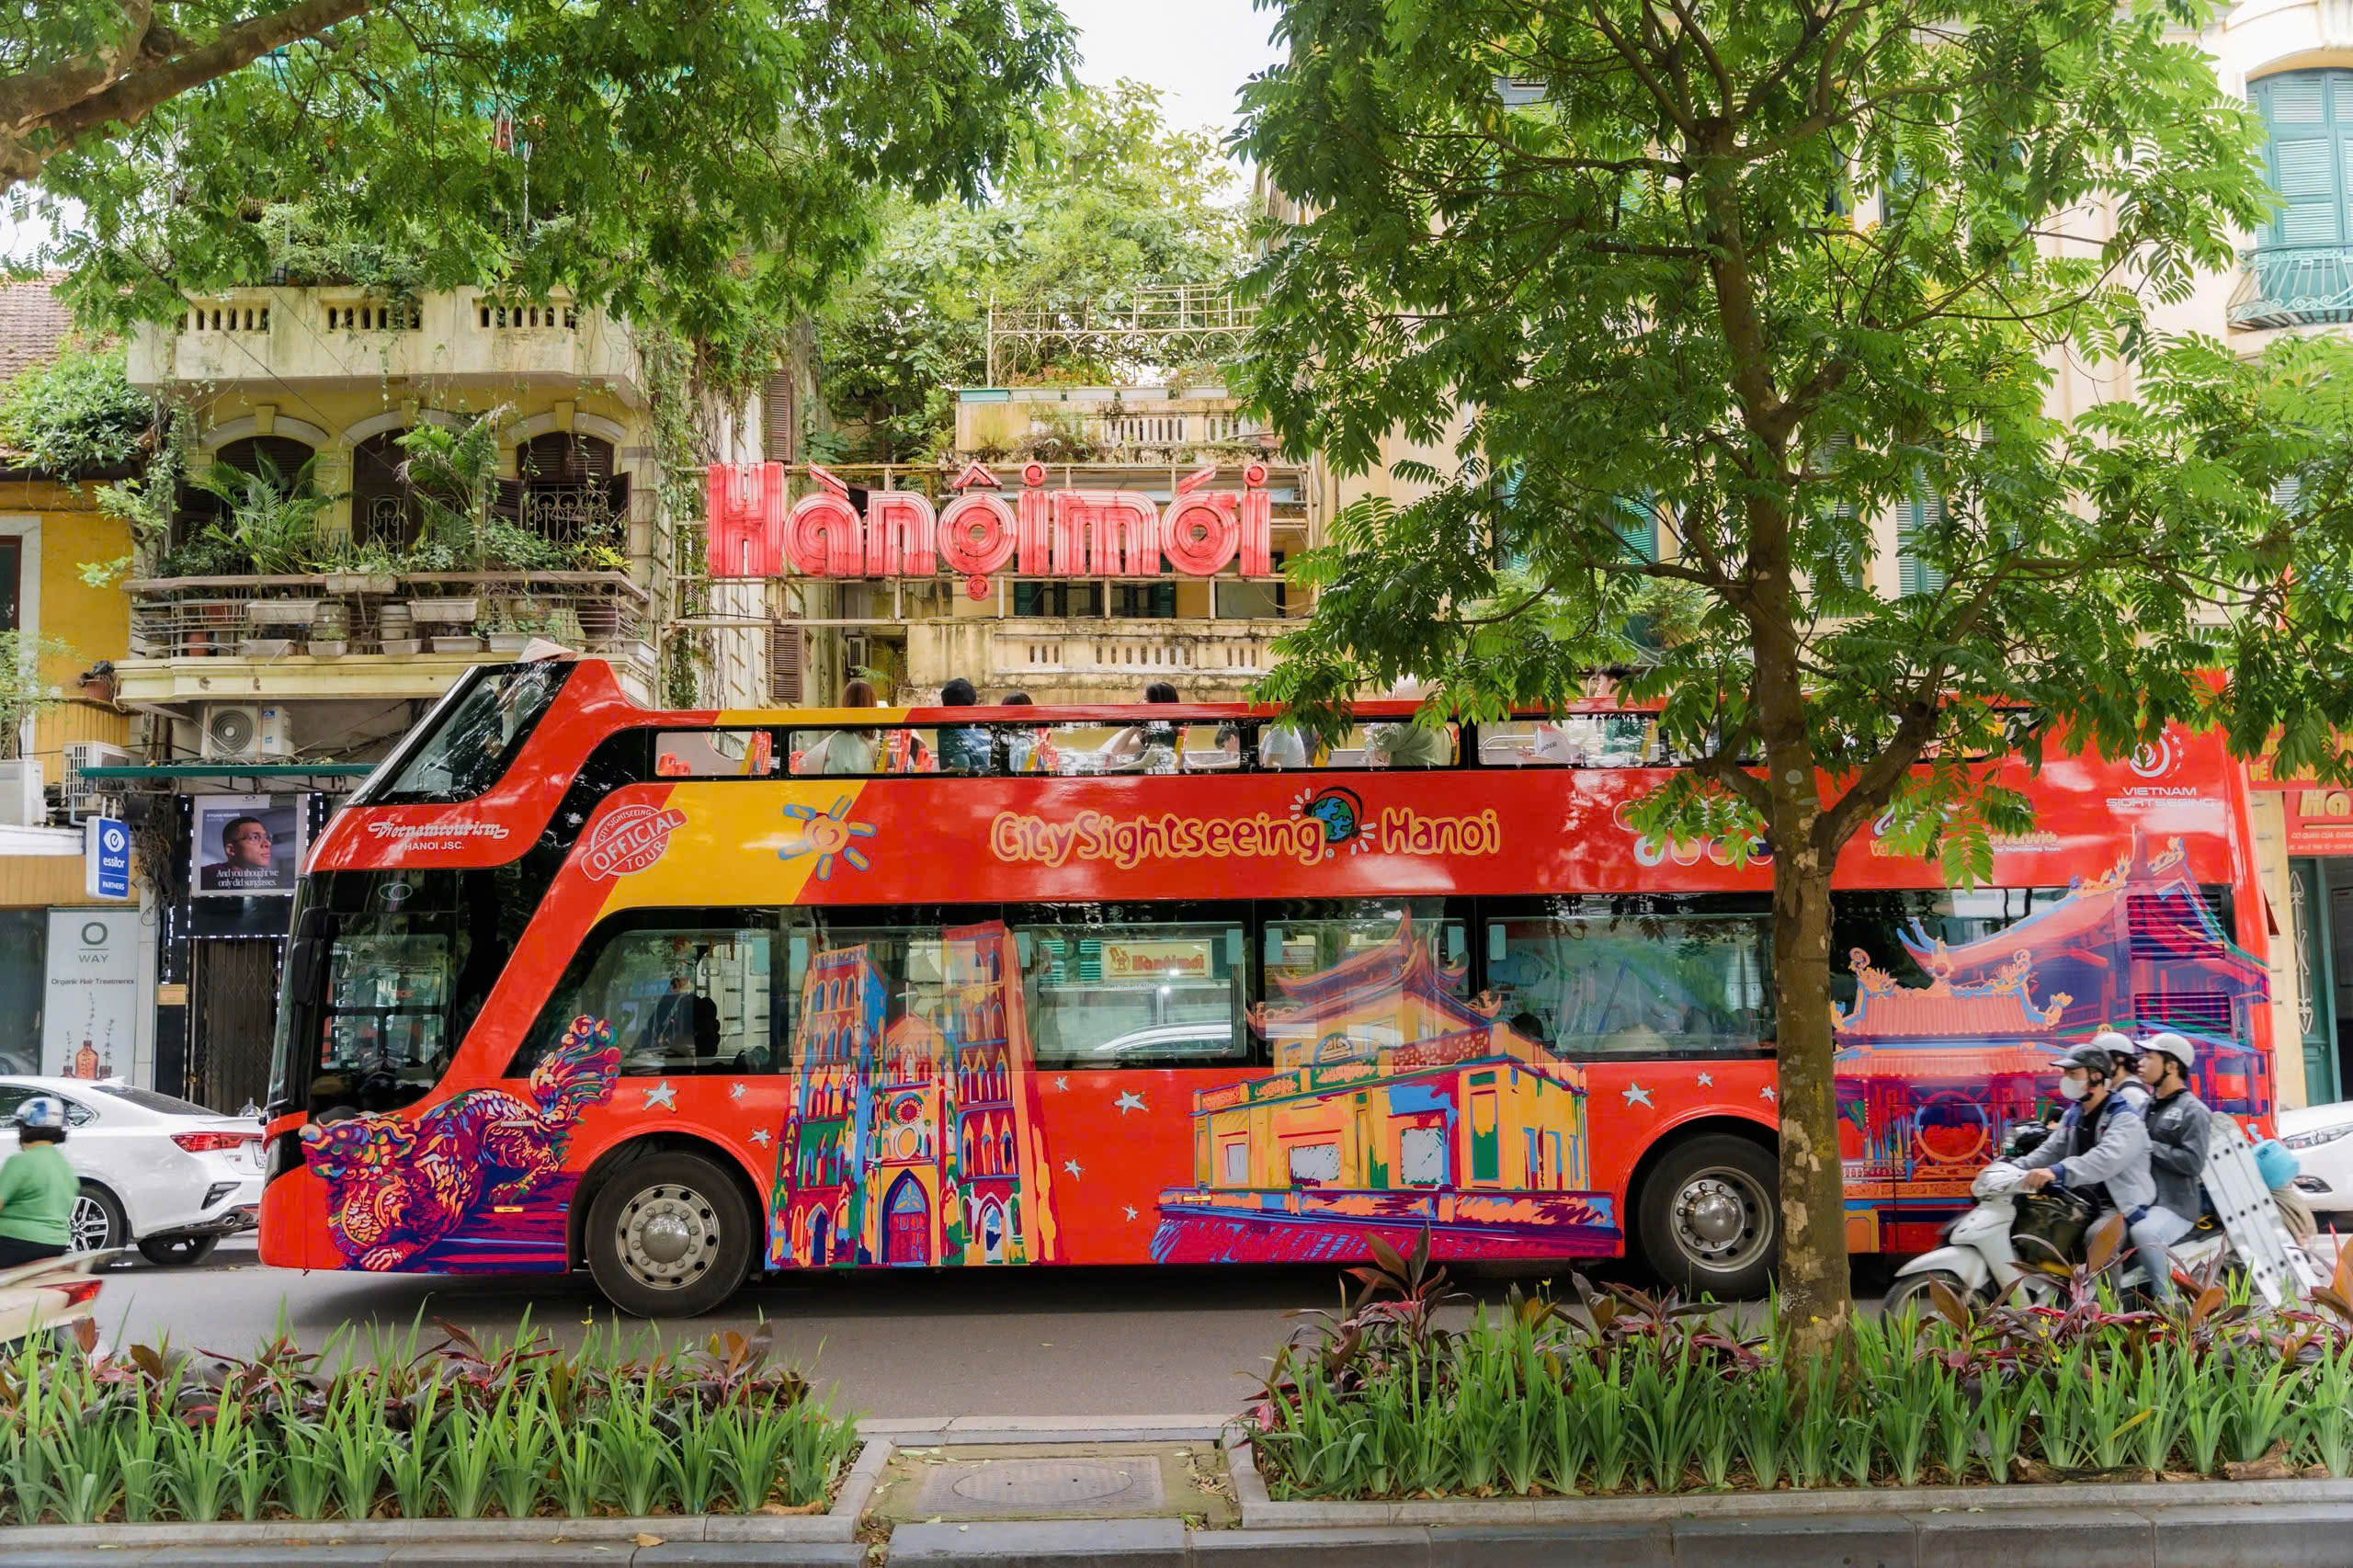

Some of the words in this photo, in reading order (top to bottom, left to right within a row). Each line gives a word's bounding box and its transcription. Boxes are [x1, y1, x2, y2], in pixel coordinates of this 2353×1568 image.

[2122, 787, 2197, 796] VIETNAM
[2106, 797, 2214, 808] SIGHTSEEING
[368, 821, 509, 839] Vietnamtourism
[597, 826, 609, 842] CITY
[608, 810, 652, 828] SIGHTSEEING
[1381, 807, 1500, 855] Hanoi
[404, 841, 438, 850] HANOI
[440, 841, 465, 850] JSC.
[593, 812, 681, 870] OFFICIAL
[626, 841, 665, 869] TOUR
[103, 856, 125, 869] essilor
[216, 868, 231, 878] And
[231, 870, 244, 879] you
[244, 868, 268, 880] thought
[102, 881, 125, 891] PARTNERS
[218, 878, 232, 889] only
[232, 878, 244, 887] did
[79, 955, 108, 963] WAY
[51, 978, 77, 987] Organic
